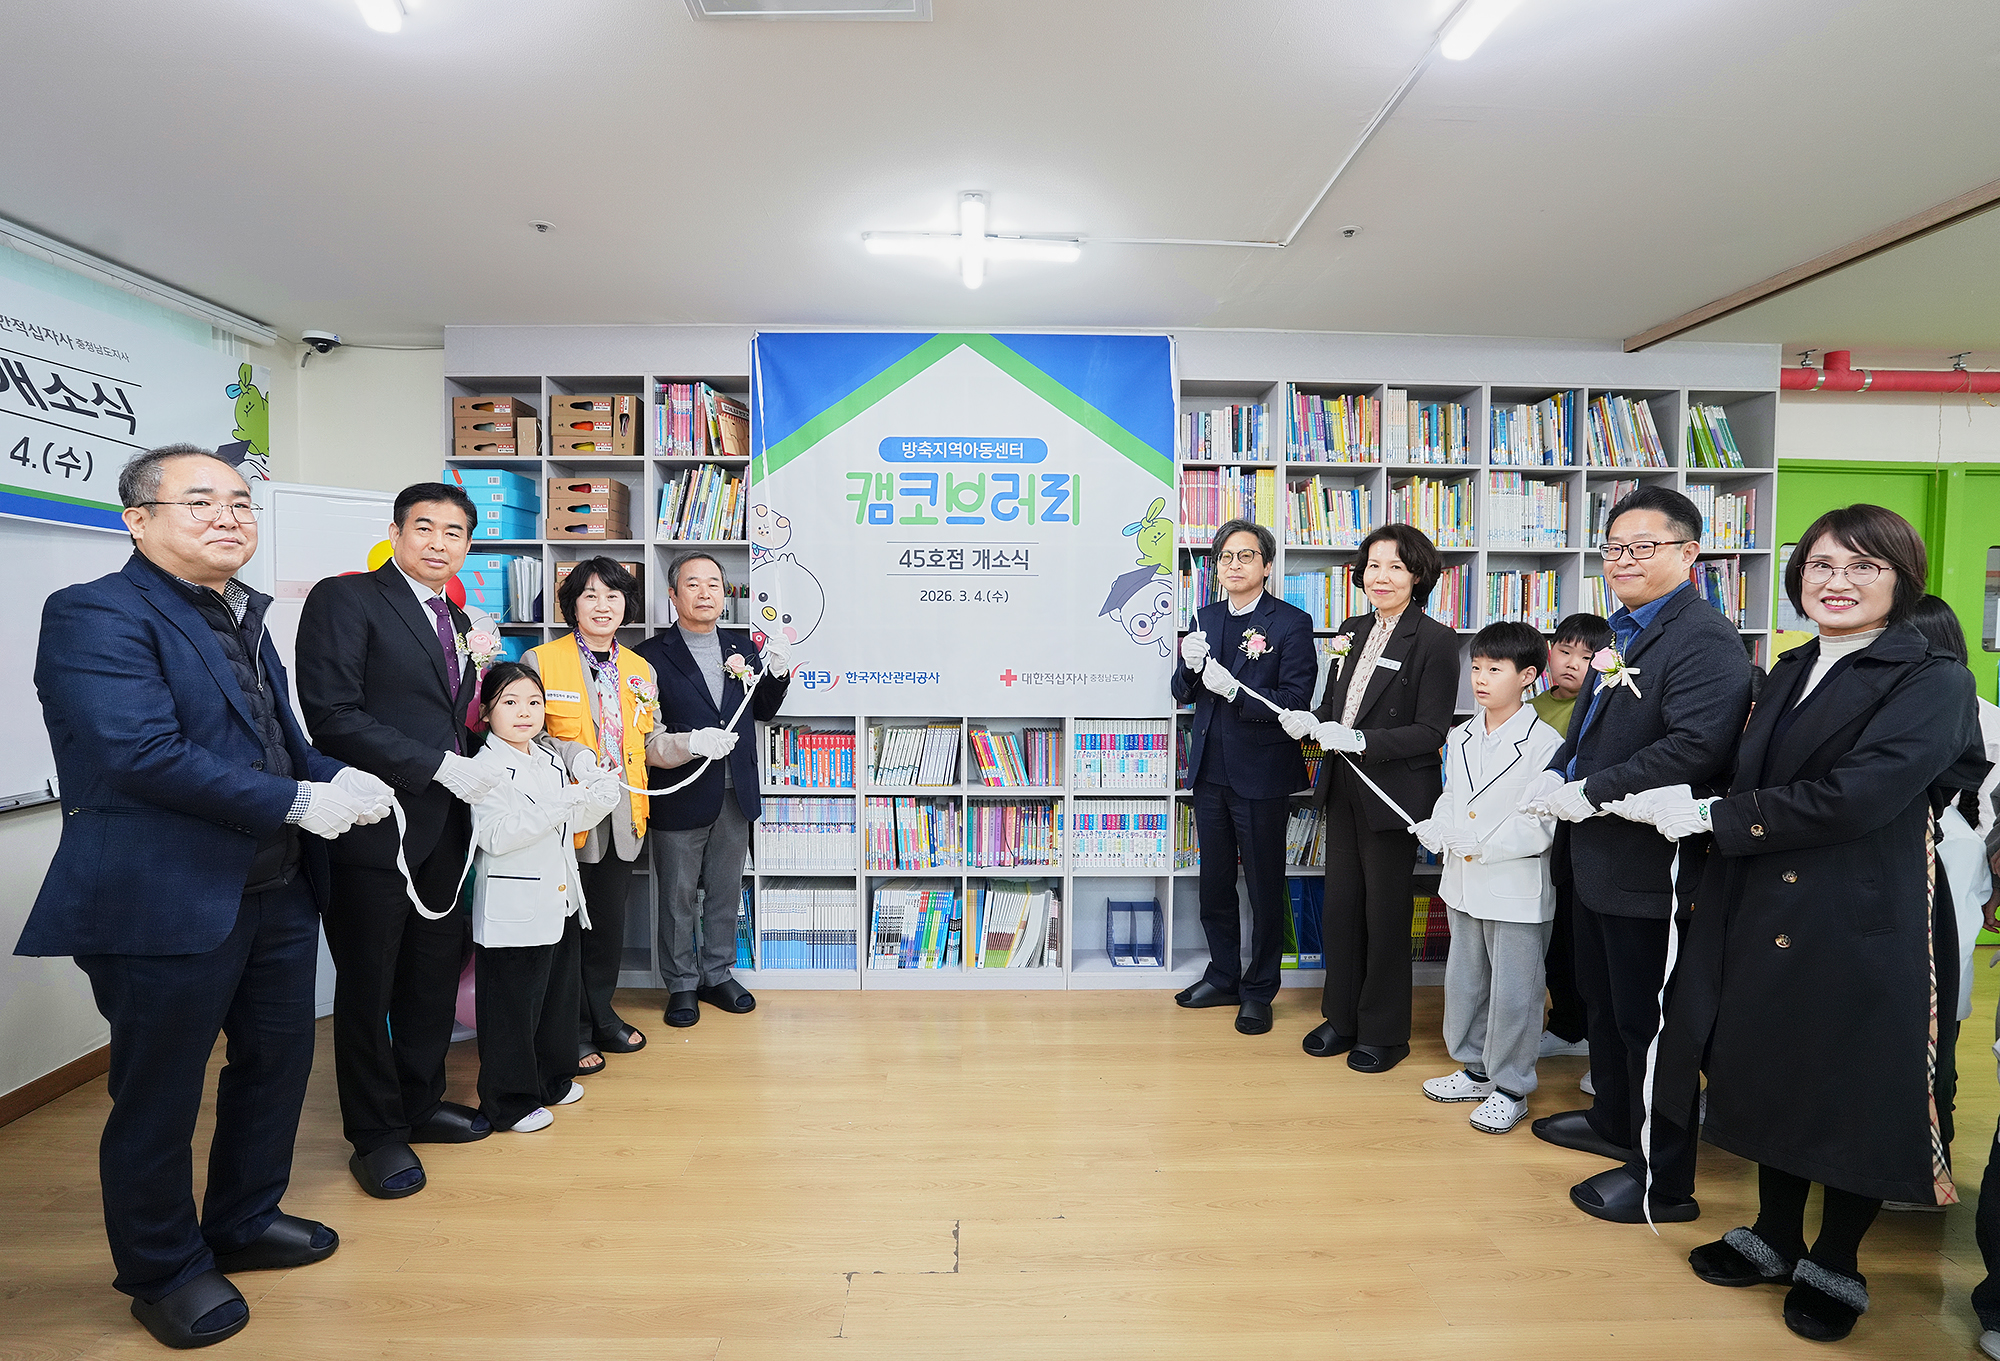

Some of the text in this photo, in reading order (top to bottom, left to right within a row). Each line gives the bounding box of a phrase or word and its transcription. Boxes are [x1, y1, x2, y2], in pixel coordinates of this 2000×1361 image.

[75, 337, 131, 363] 충청남도지사
[9, 435, 95, 482] 4.(수)
[901, 441, 1025, 459] 방축지역아동센터
[845, 471, 1081, 526] 캠코브러리
[898, 548, 1030, 571] 45호점 개소식
[919, 589, 1009, 604] 2026. 3. 4.(수)
[798, 670, 941, 690] 캠코 한국자산관리공사
[1021, 672, 1135, 686] 대한적십자사 충청남도지사
